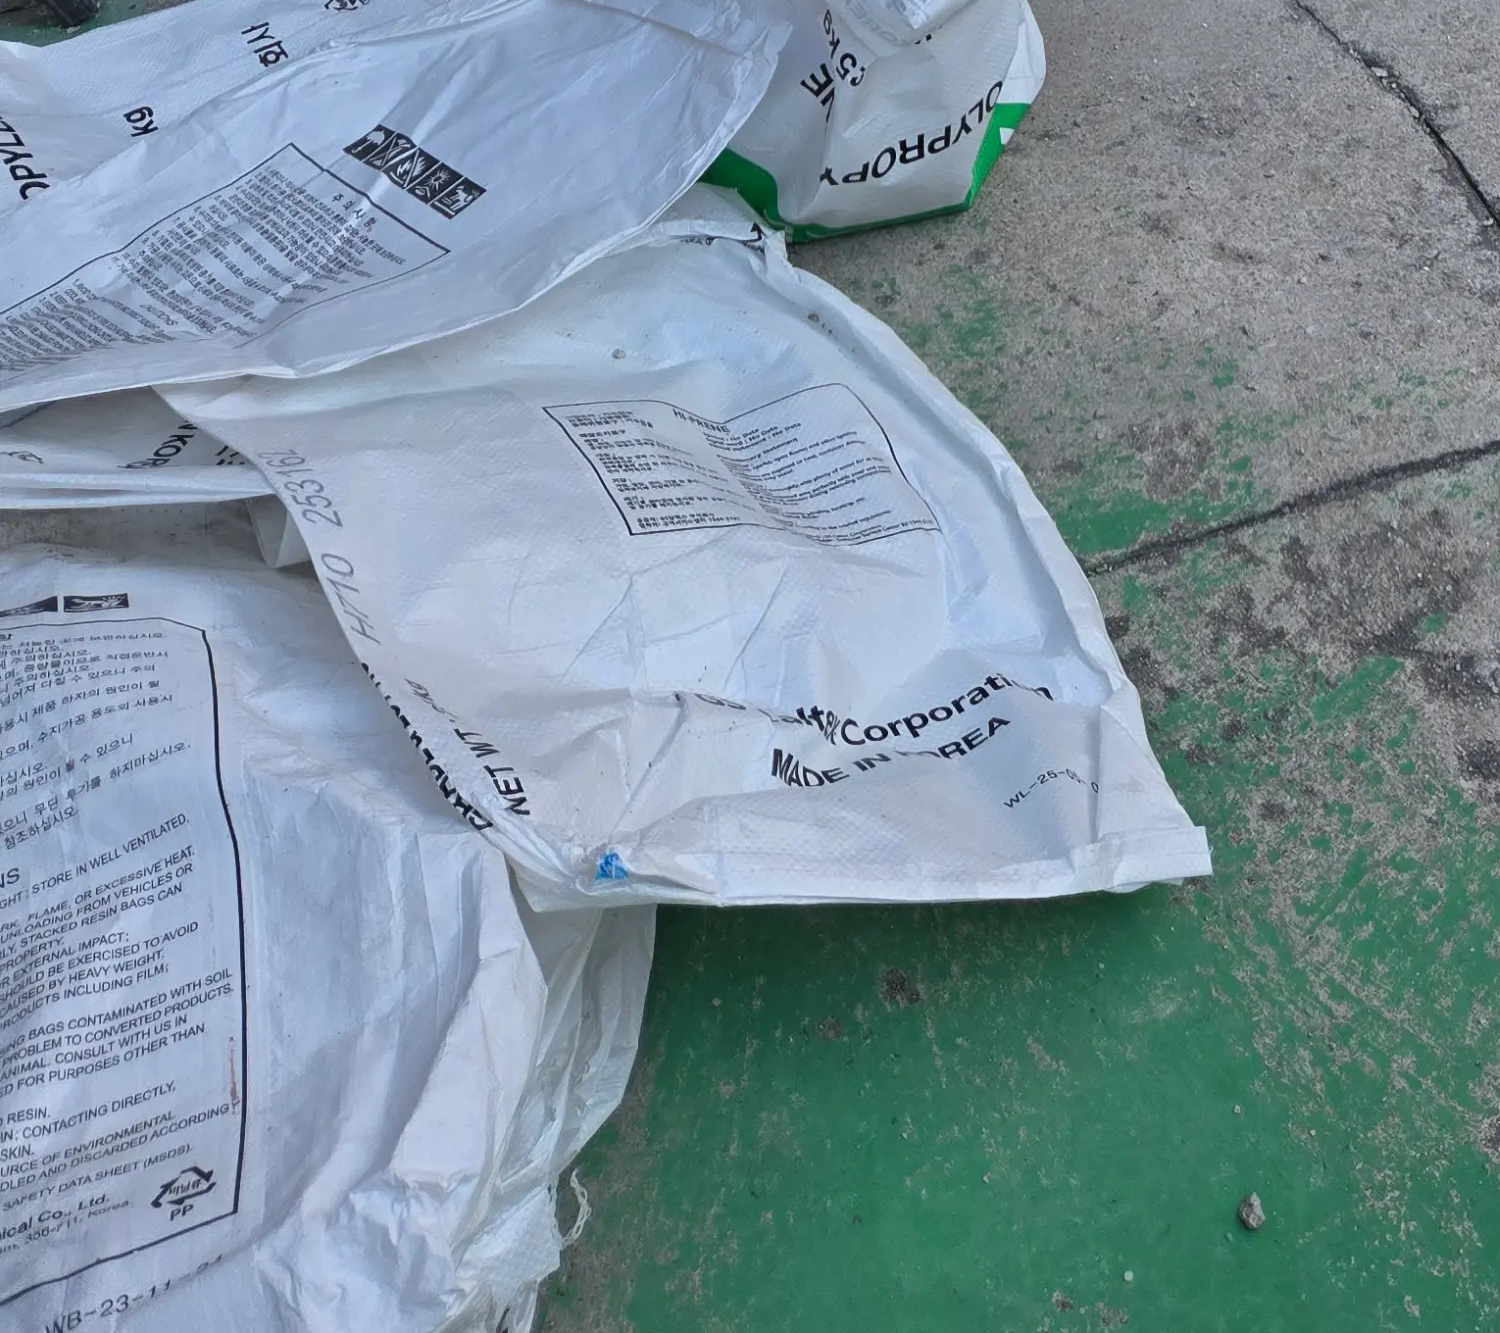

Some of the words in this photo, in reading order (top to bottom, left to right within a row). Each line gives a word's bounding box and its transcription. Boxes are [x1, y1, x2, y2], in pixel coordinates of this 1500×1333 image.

[241, 21, 289, 68] 회사
[123, 105, 158, 137] kg
[321, 552, 381, 645] H710
[11, 649, 92, 665] 주의하십시오.
[13, 665, 93, 687] 주의하십시오.
[70, 674, 83, 684] 수
[87, 667, 126, 681] 있으니
[129, 664, 156, 675] 주의
[31, 699, 57, 718] 제품
[61, 688, 100, 705] 하자의
[105, 681, 143, 696] 원인이
[37, 714, 87, 743] 수지가공
[134, 694, 173, 708] 사용시
[840, 672, 1054, 746] Corporatin
[23, 767, 61, 790] 원인이
[80, 752, 91, 764] 수
[96, 733, 133, 757] 있으니
[34, 796, 59, 816] 무단
[109, 741, 191, 780] 하지마십시오.
[769, 747, 850, 789] MADE
[853, 752, 892, 773] IN
[484, 763, 531, 816] NET
[32, 869, 73, 895] STORE
[76, 862, 88, 878] IN
[89, 848, 121, 873] WELL
[122, 813, 191, 854] VENTILATED,
[0, 911, 73, 945] UNLOADING
[77, 894, 111, 918] FROM
[114, 871, 173, 902] VEHICLES
[175, 862, 194, 879] OR
[75, 890, 92, 905] OR
[95, 863, 163, 896] EXCESSIVE
[20, 921, 78, 949] STACKED
[81, 906, 118, 929] RESIN
[120, 894, 155, 915] BAGS
[157, 882, 183, 903] CAN
[0, 971, 45, 1004] SHOULD
[47, 962, 65, 978] BE
[67, 943, 140, 972] EXERCISED
[143, 935, 160, 951] TO
[161, 921, 199, 945] AVOID
[0, 984, 45, 1018] CAUSED
[48, 976, 66, 991] BY
[69, 965, 111, 985] HEAVY
[113, 948, 165, 974] WEIGHT.
[13, 947, 76, 985] EXTERNAL
[63, 976, 134, 1000] INCLUDING
[1, 1037, 63, 1069] PROBLEM
[66, 1032, 83, 1048] TO
[84, 1009, 162, 1045] CONVERTED
[164, 982, 235, 1017] PRODUCTS.
[28, 1019, 65, 1041] BAGS
[67, 993, 168, 1031] CONTAMINATED
[169, 978, 202, 999] WITH
[204, 967, 233, 985] SOIL
[17, 1073, 46, 1092] FOR
[49, 1054, 121, 1083] PURPOSES
[123, 1038, 169, 1061] OTHER
[171, 1022, 207, 1044] THAN
[54, 1040, 115, 1066] CONSULT
[118, 1029, 152, 1049] WITH
[154, 1019, 172, 1035] US
[174, 1013, 188, 1028] IN
[7, 1106, 51, 1126] RESIN.
[22, 1104, 109, 1141] CONTACTING
[111, 1080, 177, 1114] DIRECTLY,
[38, 1162, 68, 1185] AND
[70, 1135, 149, 1169] DISCARDED
[150, 1105, 230, 1144] ACCORDING
[41, 1152, 62, 1167] OF
[64, 1111, 176, 1160] ENVIRONMENTAL
[3, 1183, 57, 1212] SAFETY
[58, 1174, 93, 1195] DATA
[94, 1162, 140, 1182] SHEET
[78, 1193, 111, 1213] Ltd.
[87, 1200, 131, 1220] Korea
[169, 1203, 195, 1222] PP
